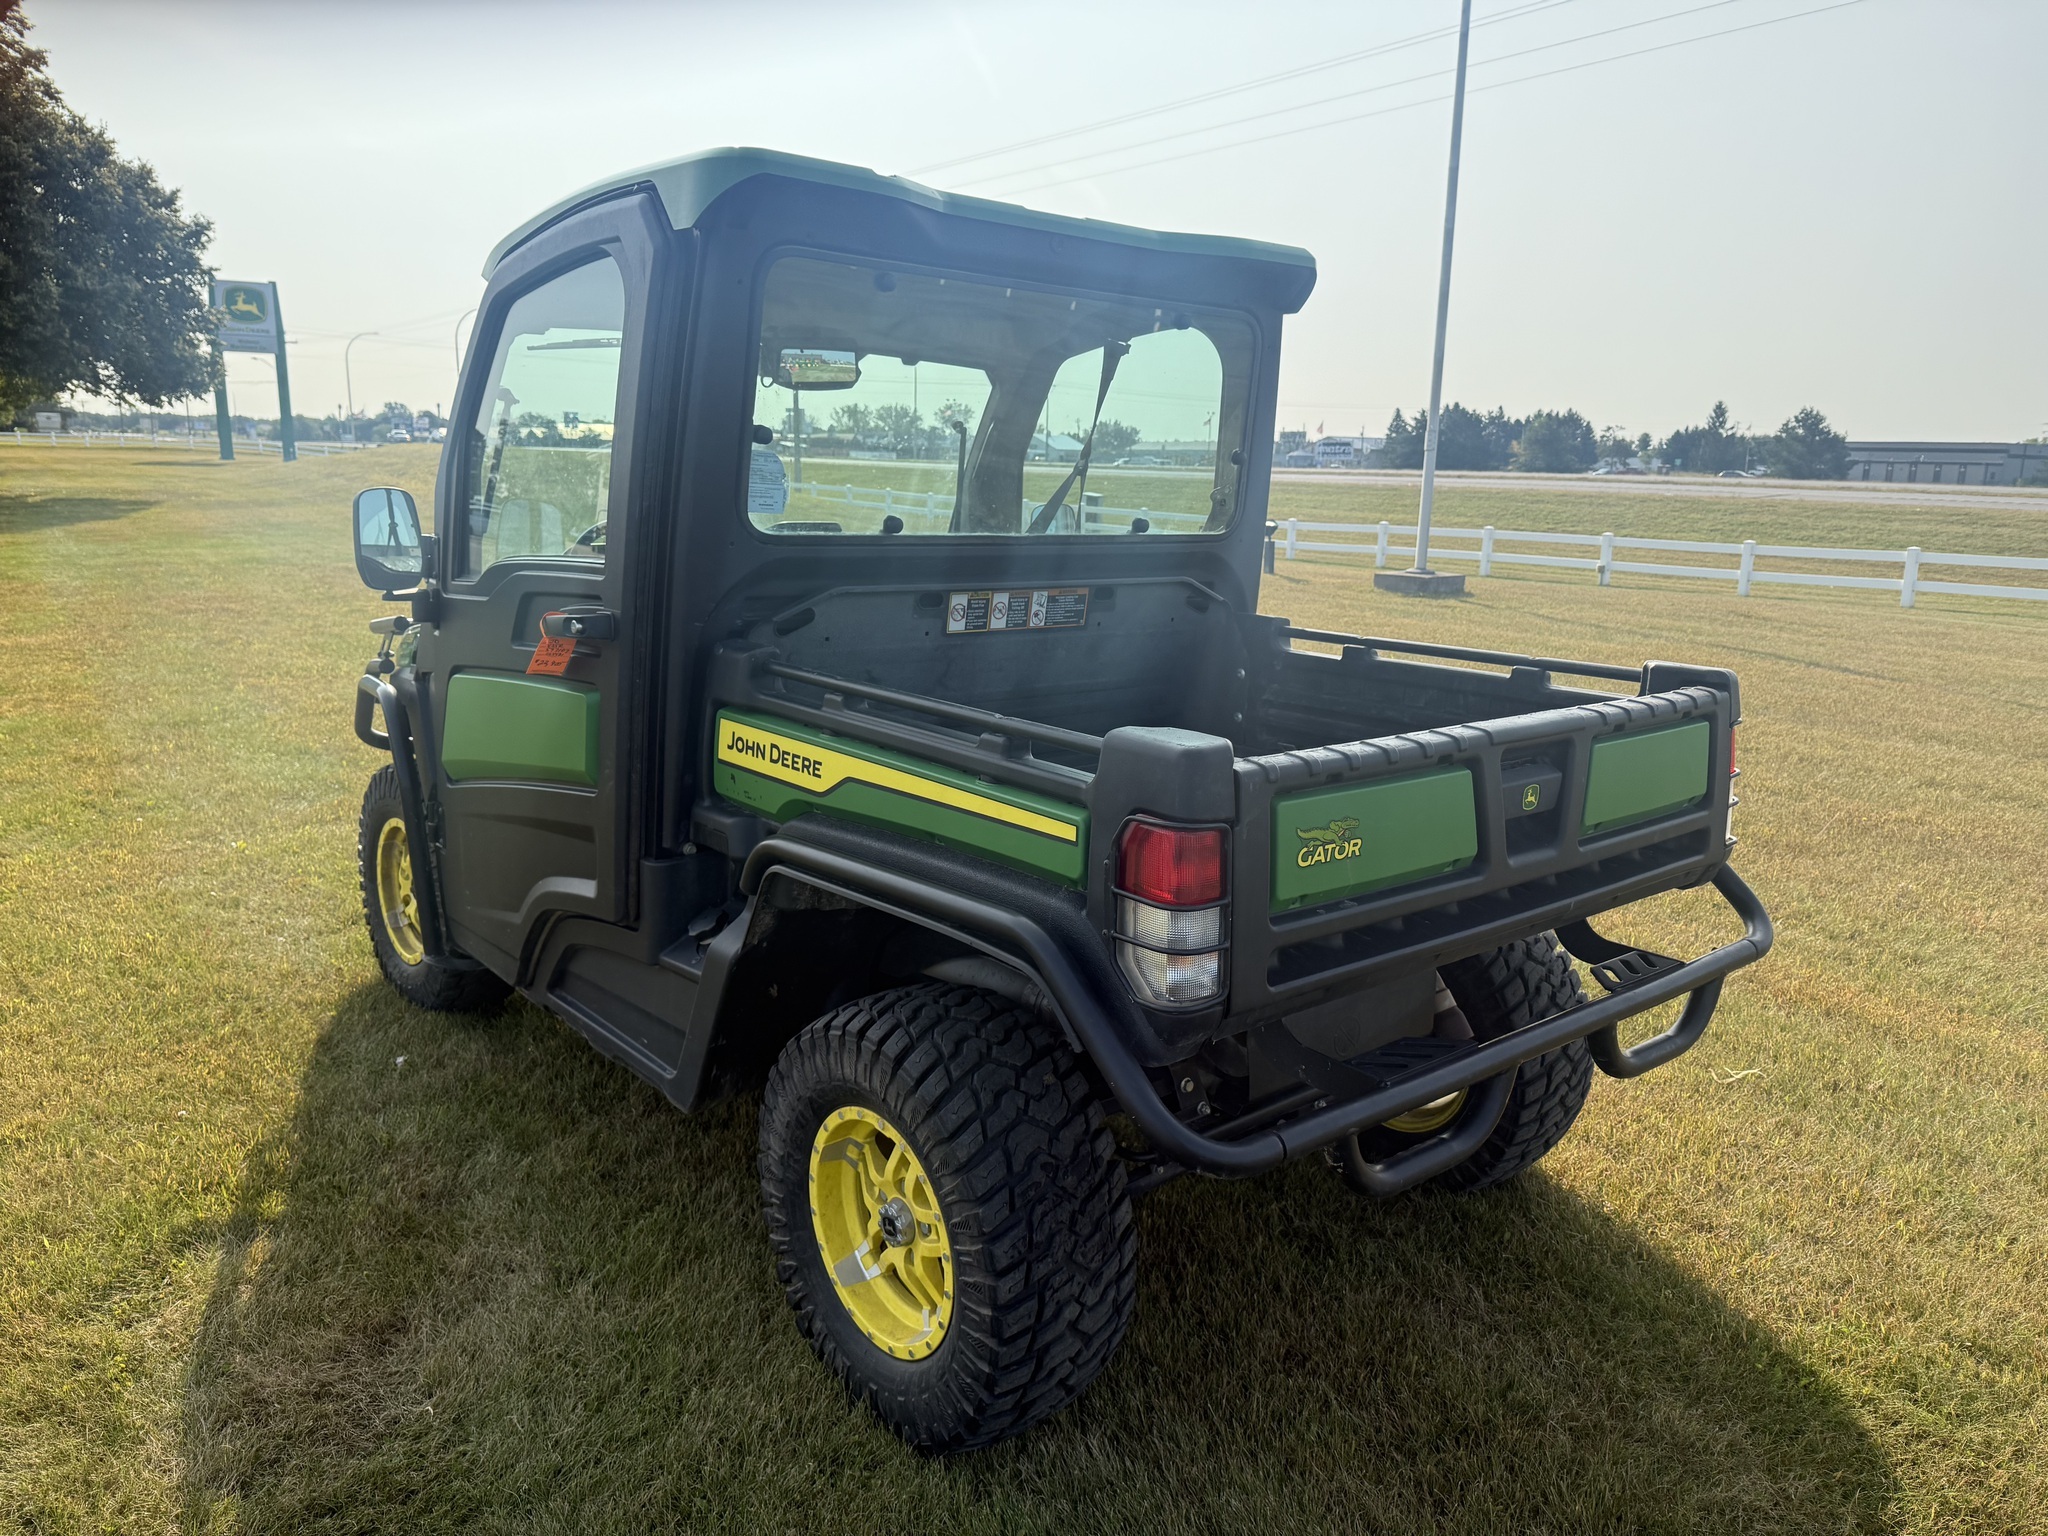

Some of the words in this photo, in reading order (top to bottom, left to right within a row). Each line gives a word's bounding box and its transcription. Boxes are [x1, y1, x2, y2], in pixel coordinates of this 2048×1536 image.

[727, 731, 766, 761] JOHN
[769, 743, 823, 779] DEERE
[1297, 838, 1362, 868] GATOR
